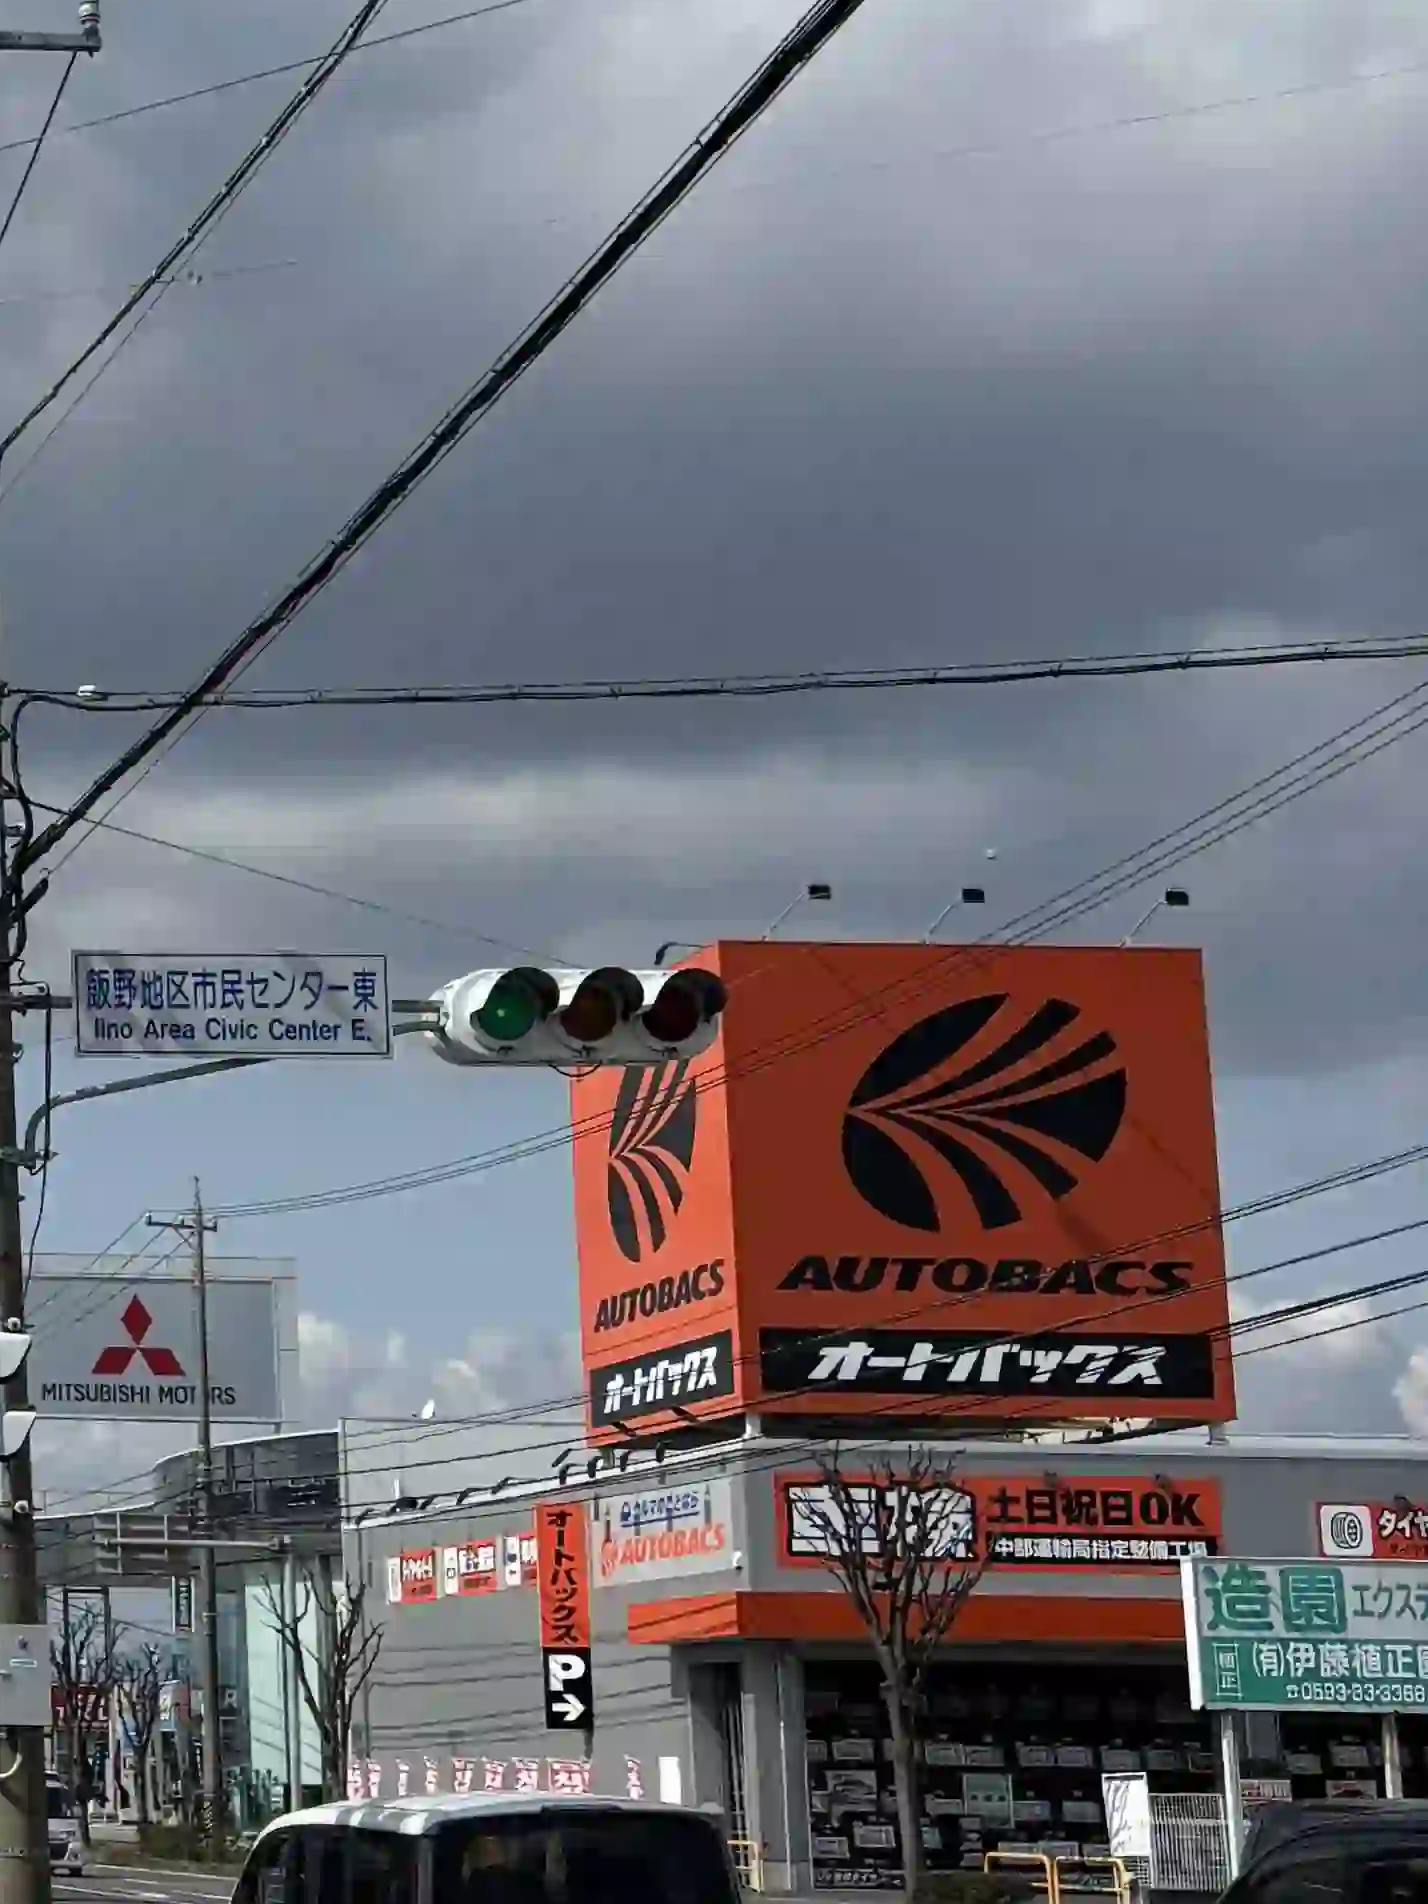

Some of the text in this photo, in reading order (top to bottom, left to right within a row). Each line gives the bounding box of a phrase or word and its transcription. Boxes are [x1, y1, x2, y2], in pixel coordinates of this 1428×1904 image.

[86, 968, 378, 1012] 飯野地区市民センター東
[94, 1018, 372, 1041] Iino Area Civic Center E.
[593, 1258, 725, 1333] AUTOBACS
[776, 1254, 1194, 1295] AUTOBACS
[603, 1346, 717, 1414] オートバックス
[807, 1340, 1167, 1386] オートバックス
[42, 1383, 150, 1405] MITSUBISHI
[620, 1523, 725, 1566] AUTOBACS
[546, 1510, 579, 1644] オートバックス
[1202, 1562, 1347, 1634] 造園
[548, 1654, 586, 1692] P
